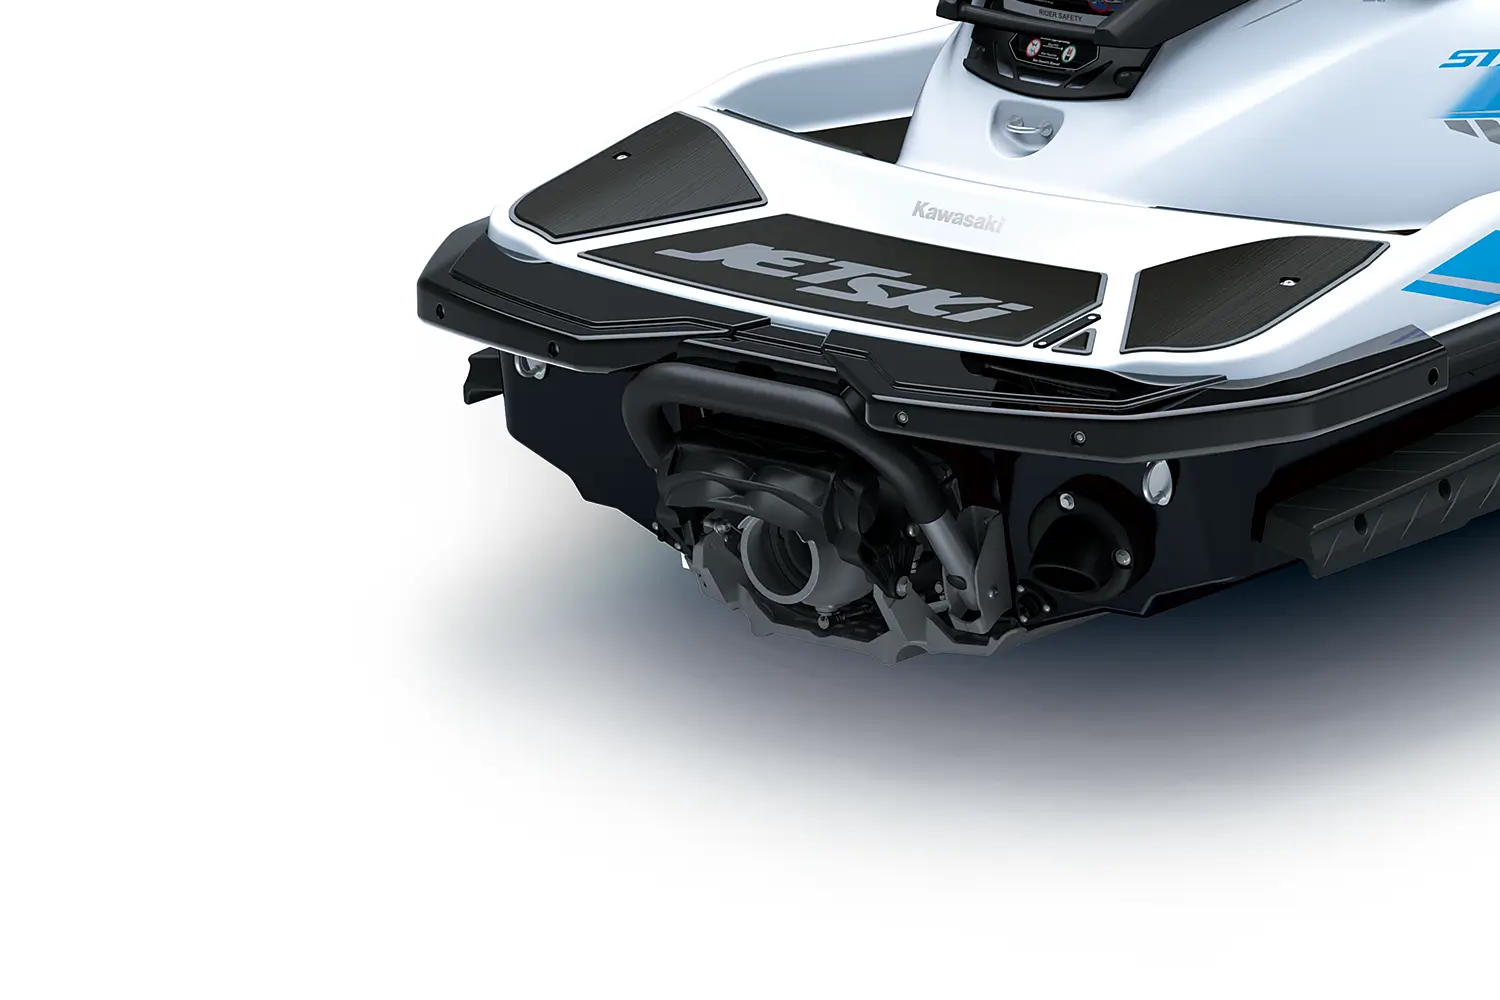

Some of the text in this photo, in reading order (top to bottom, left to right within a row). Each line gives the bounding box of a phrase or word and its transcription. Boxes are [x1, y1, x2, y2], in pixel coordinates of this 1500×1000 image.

[1038, 8, 1083, 22] RIDER SAFETY
[911, 200, 1006, 234] Kawasaki
